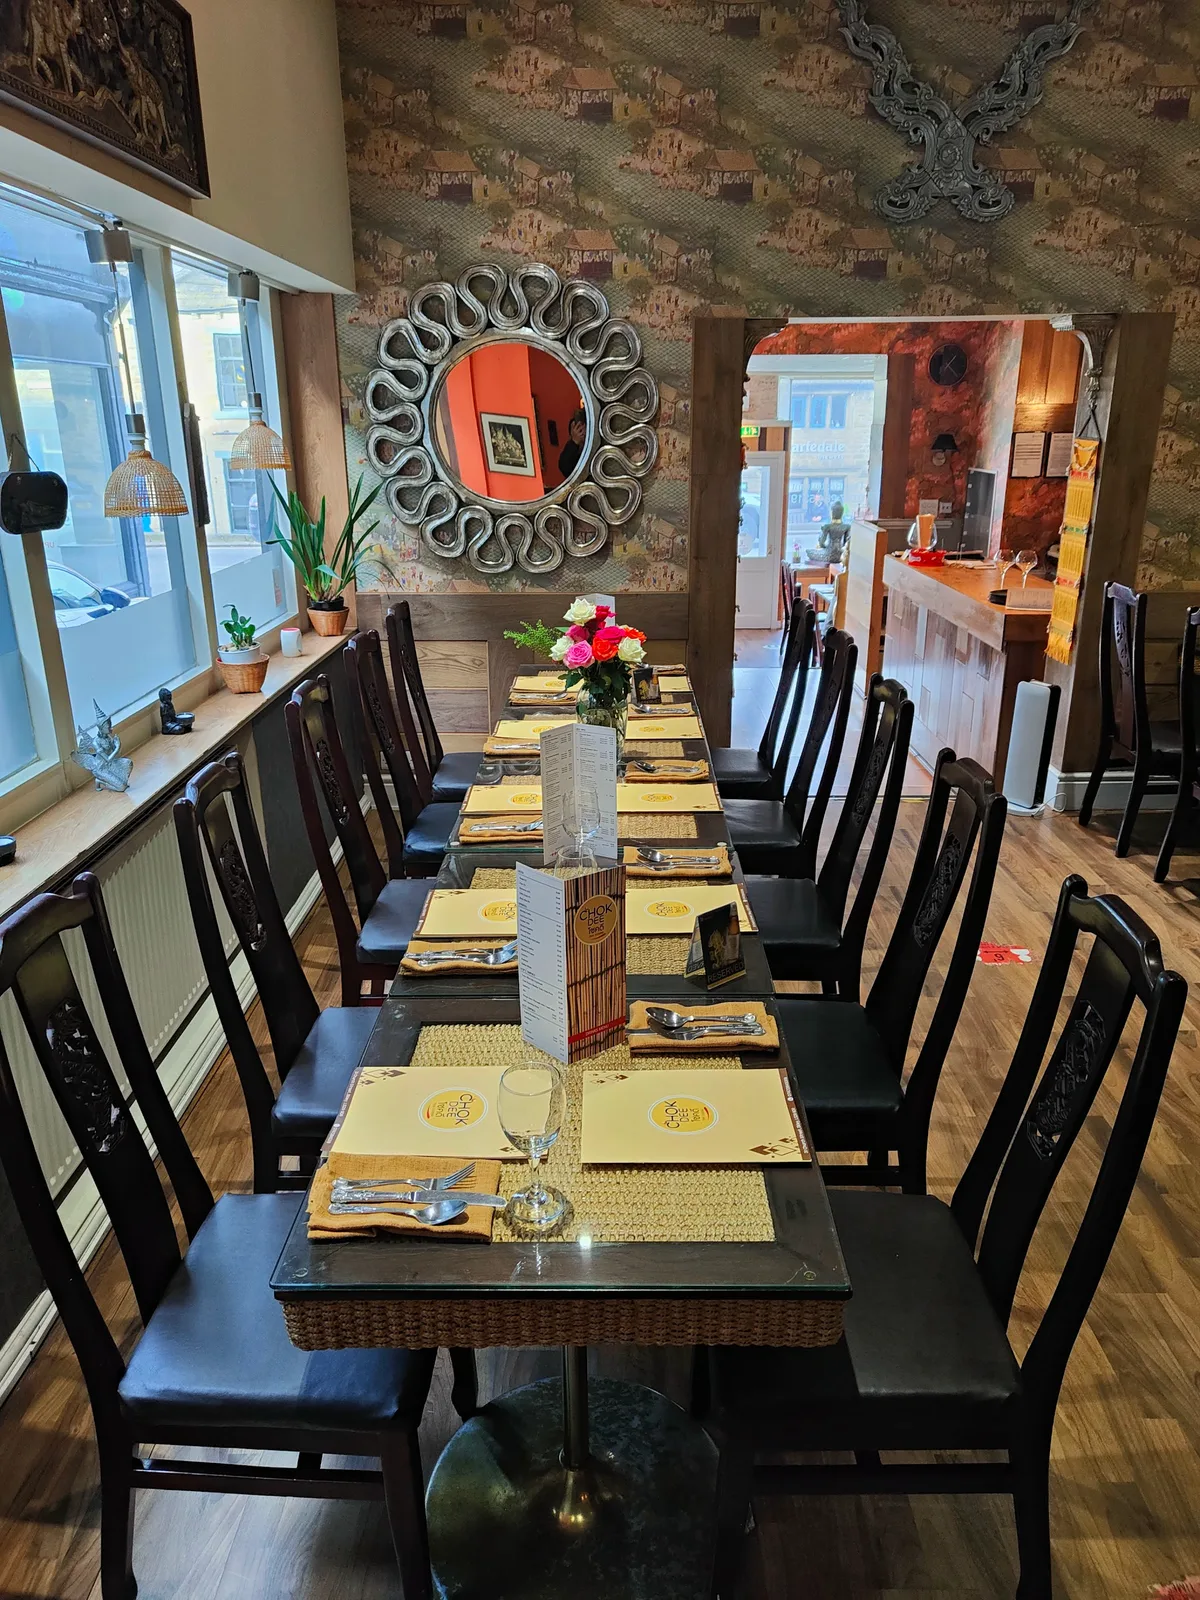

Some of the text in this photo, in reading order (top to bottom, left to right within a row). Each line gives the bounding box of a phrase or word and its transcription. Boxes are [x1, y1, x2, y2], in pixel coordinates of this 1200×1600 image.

[580, 902, 613, 921] CHOK
[588, 915, 604, 926] DEE
[708, 962, 743, 983] RESERVED
[446, 1101, 458, 1117] DEE
[455, 1094, 473, 1125] CHOK
[664, 1100, 680, 1129] CHOK
[679, 1108, 689, 1122] DEE
